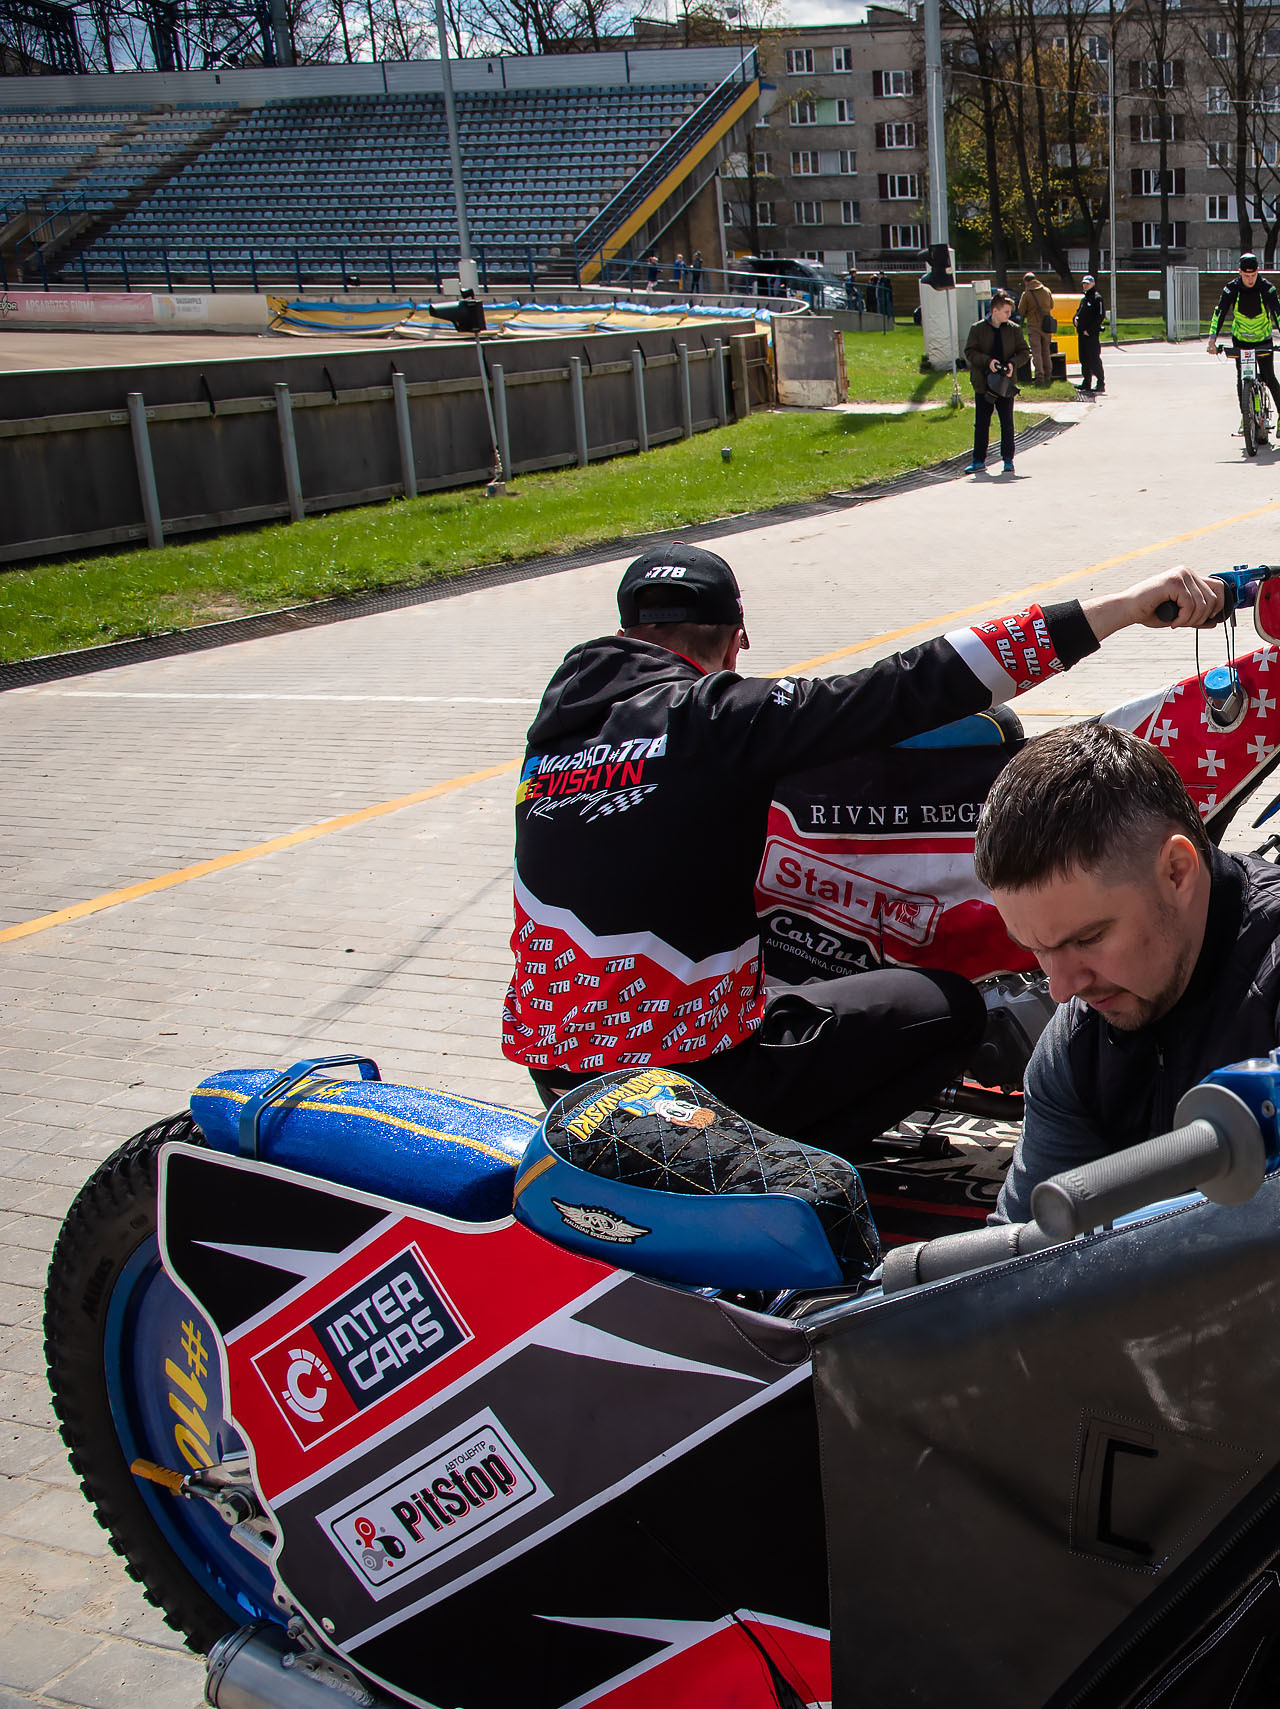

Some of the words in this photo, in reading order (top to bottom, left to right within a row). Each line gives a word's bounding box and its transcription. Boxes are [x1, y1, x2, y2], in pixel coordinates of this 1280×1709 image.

[525, 760, 644, 800] LEVISHYN
[810, 805, 909, 825] RIVNE
[326, 1271, 424, 1357] INTER
[348, 1306, 444, 1391] CARS
[445, 1440, 486, 1473] АВТОЦЕНТР
[390, 1453, 517, 1543] PitStop
